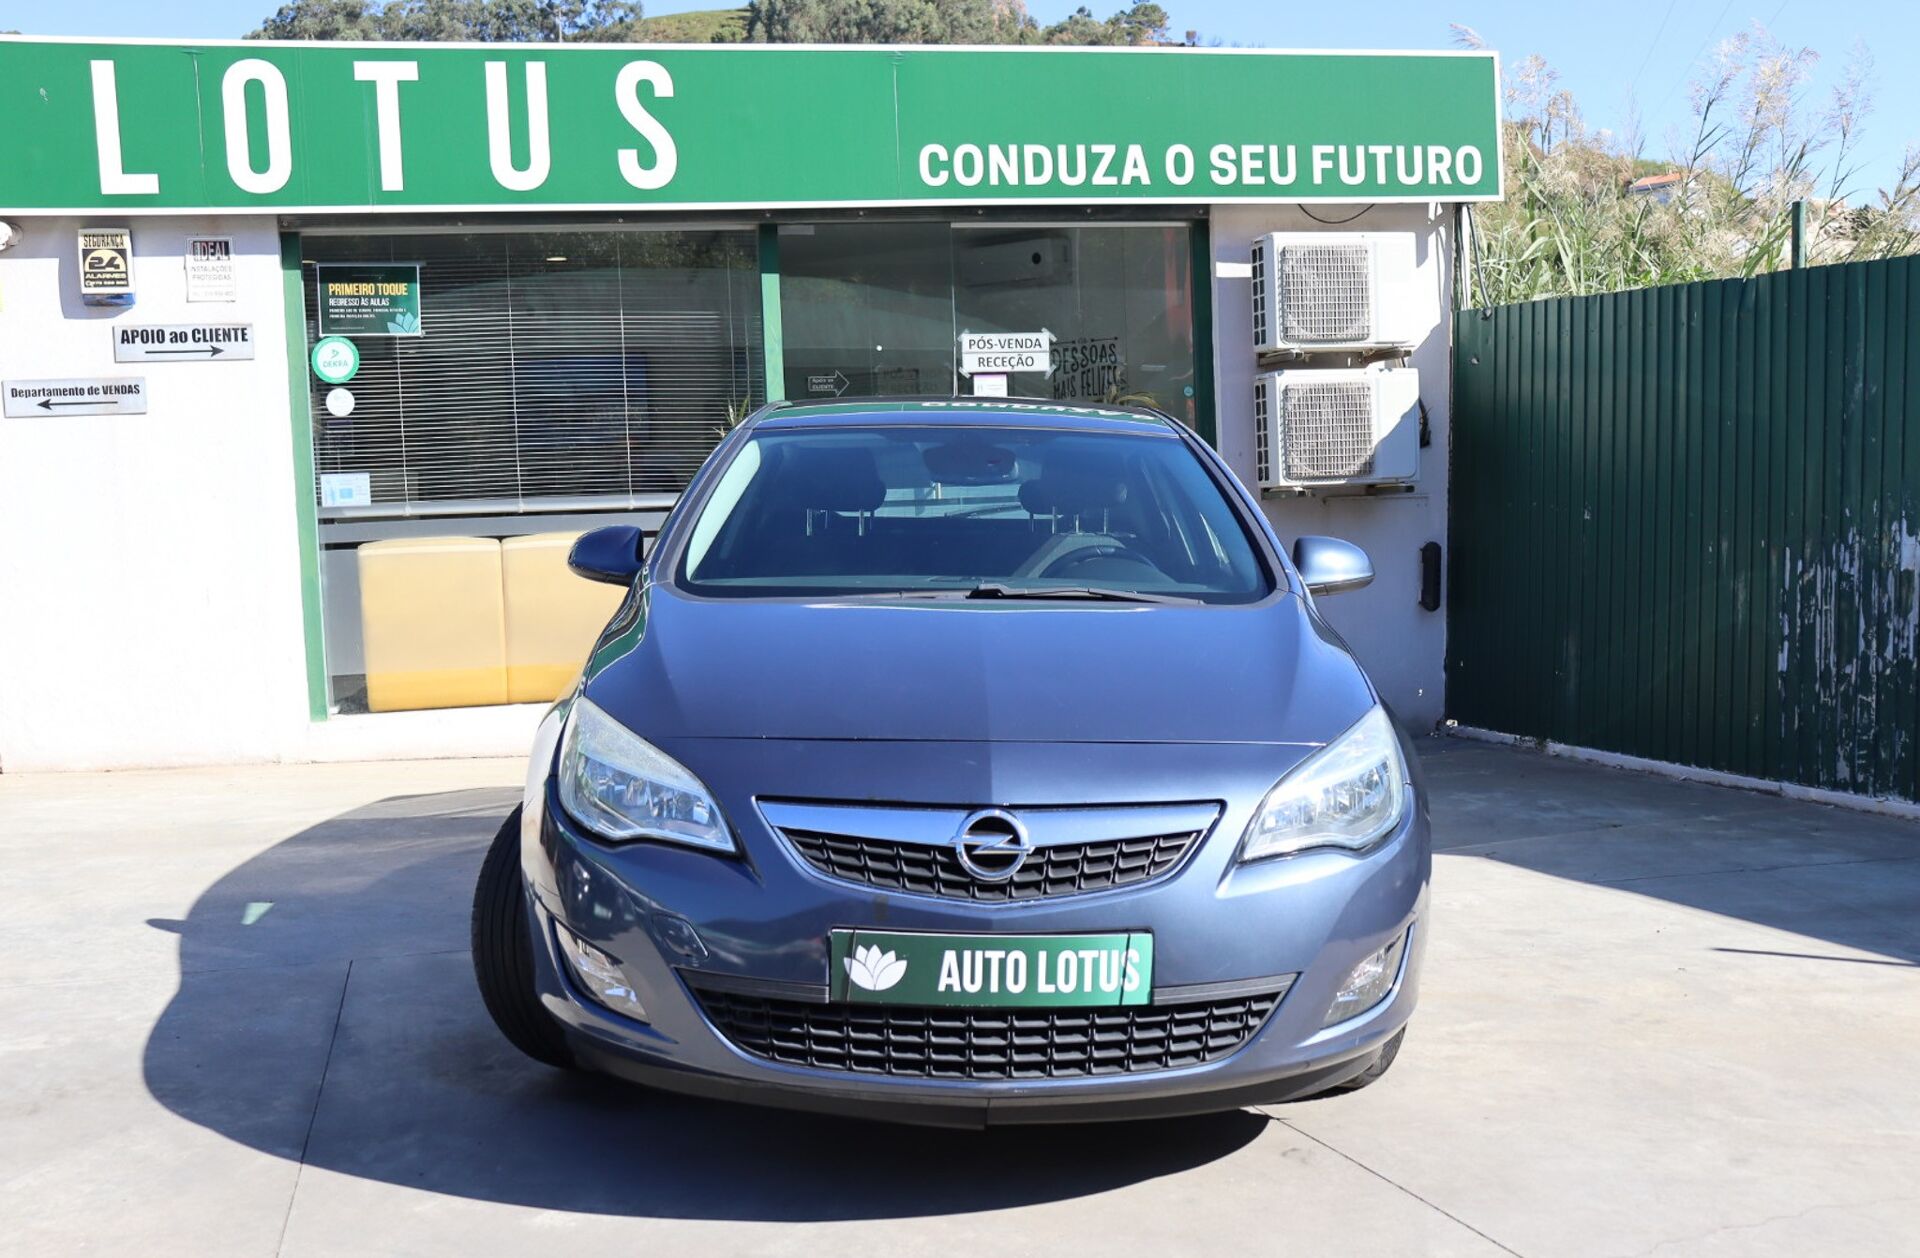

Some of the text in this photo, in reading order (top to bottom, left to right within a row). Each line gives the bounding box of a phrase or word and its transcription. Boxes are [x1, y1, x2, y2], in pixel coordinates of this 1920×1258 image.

[91, 58, 678, 194] LOTUS
[918, 144, 1483, 186] CONDUZA O SEU FUTURO
[84, 234, 124, 248] SEGURANÇA
[88, 256, 121, 270] 24
[328, 283, 408, 296] PRIMEIRO TOQUE
[329, 298, 360, 306] REGRESSO
[370, 298, 390, 306] AULAS
[120, 327, 249, 345] APOIO ao CLIENTE
[968, 335, 1042, 350] PÓS-VENDA
[978, 354, 1034, 369] RECEÇÃO
[1050, 343, 1118, 382] PESSOAS
[11, 384, 140, 398] Departamento de VENDAS
[1053, 375, 1077, 400] MAIS
[938, 949, 1140, 994] AUTO LOTUS
